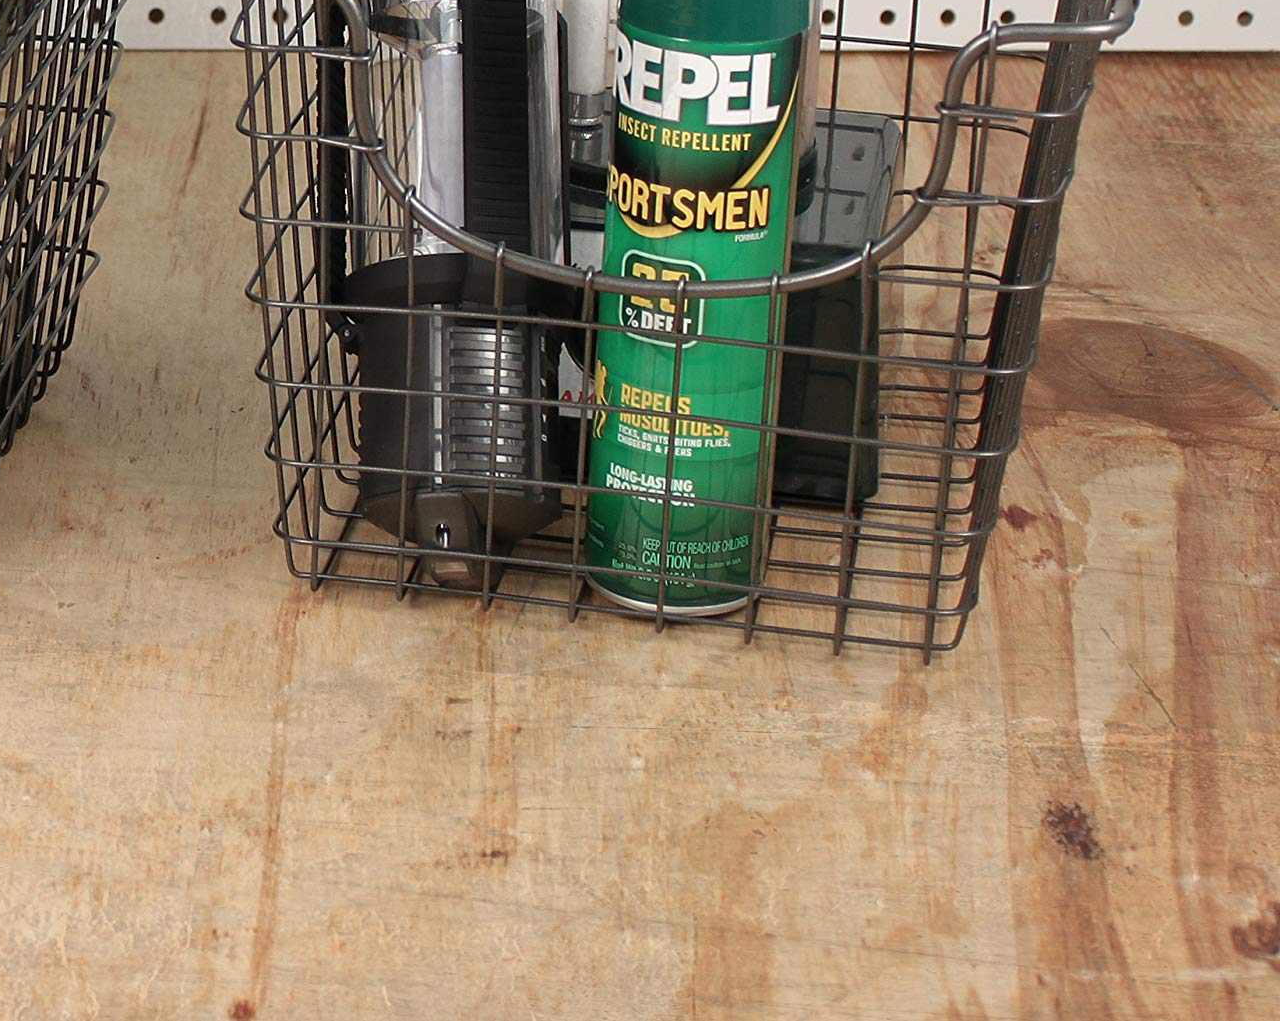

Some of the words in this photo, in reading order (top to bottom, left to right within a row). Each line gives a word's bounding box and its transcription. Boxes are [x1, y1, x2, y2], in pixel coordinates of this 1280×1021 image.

[613, 28, 780, 126] REPEL
[619, 112, 656, 142] INSECT
[662, 128, 752, 152] REPELLENT
[606, 162, 769, 230] PORTSMEN
[621, 383, 691, 415] REPELS
[654, 444, 662, 454] &
[674, 438, 702, 448] BITING
[610, 462, 693, 492] LONG-LASTING
[643, 537, 661, 550] KEEP
[676, 542, 687, 554] OF
[687, 541, 711, 554] REACH
[712, 541, 721, 552] OF
